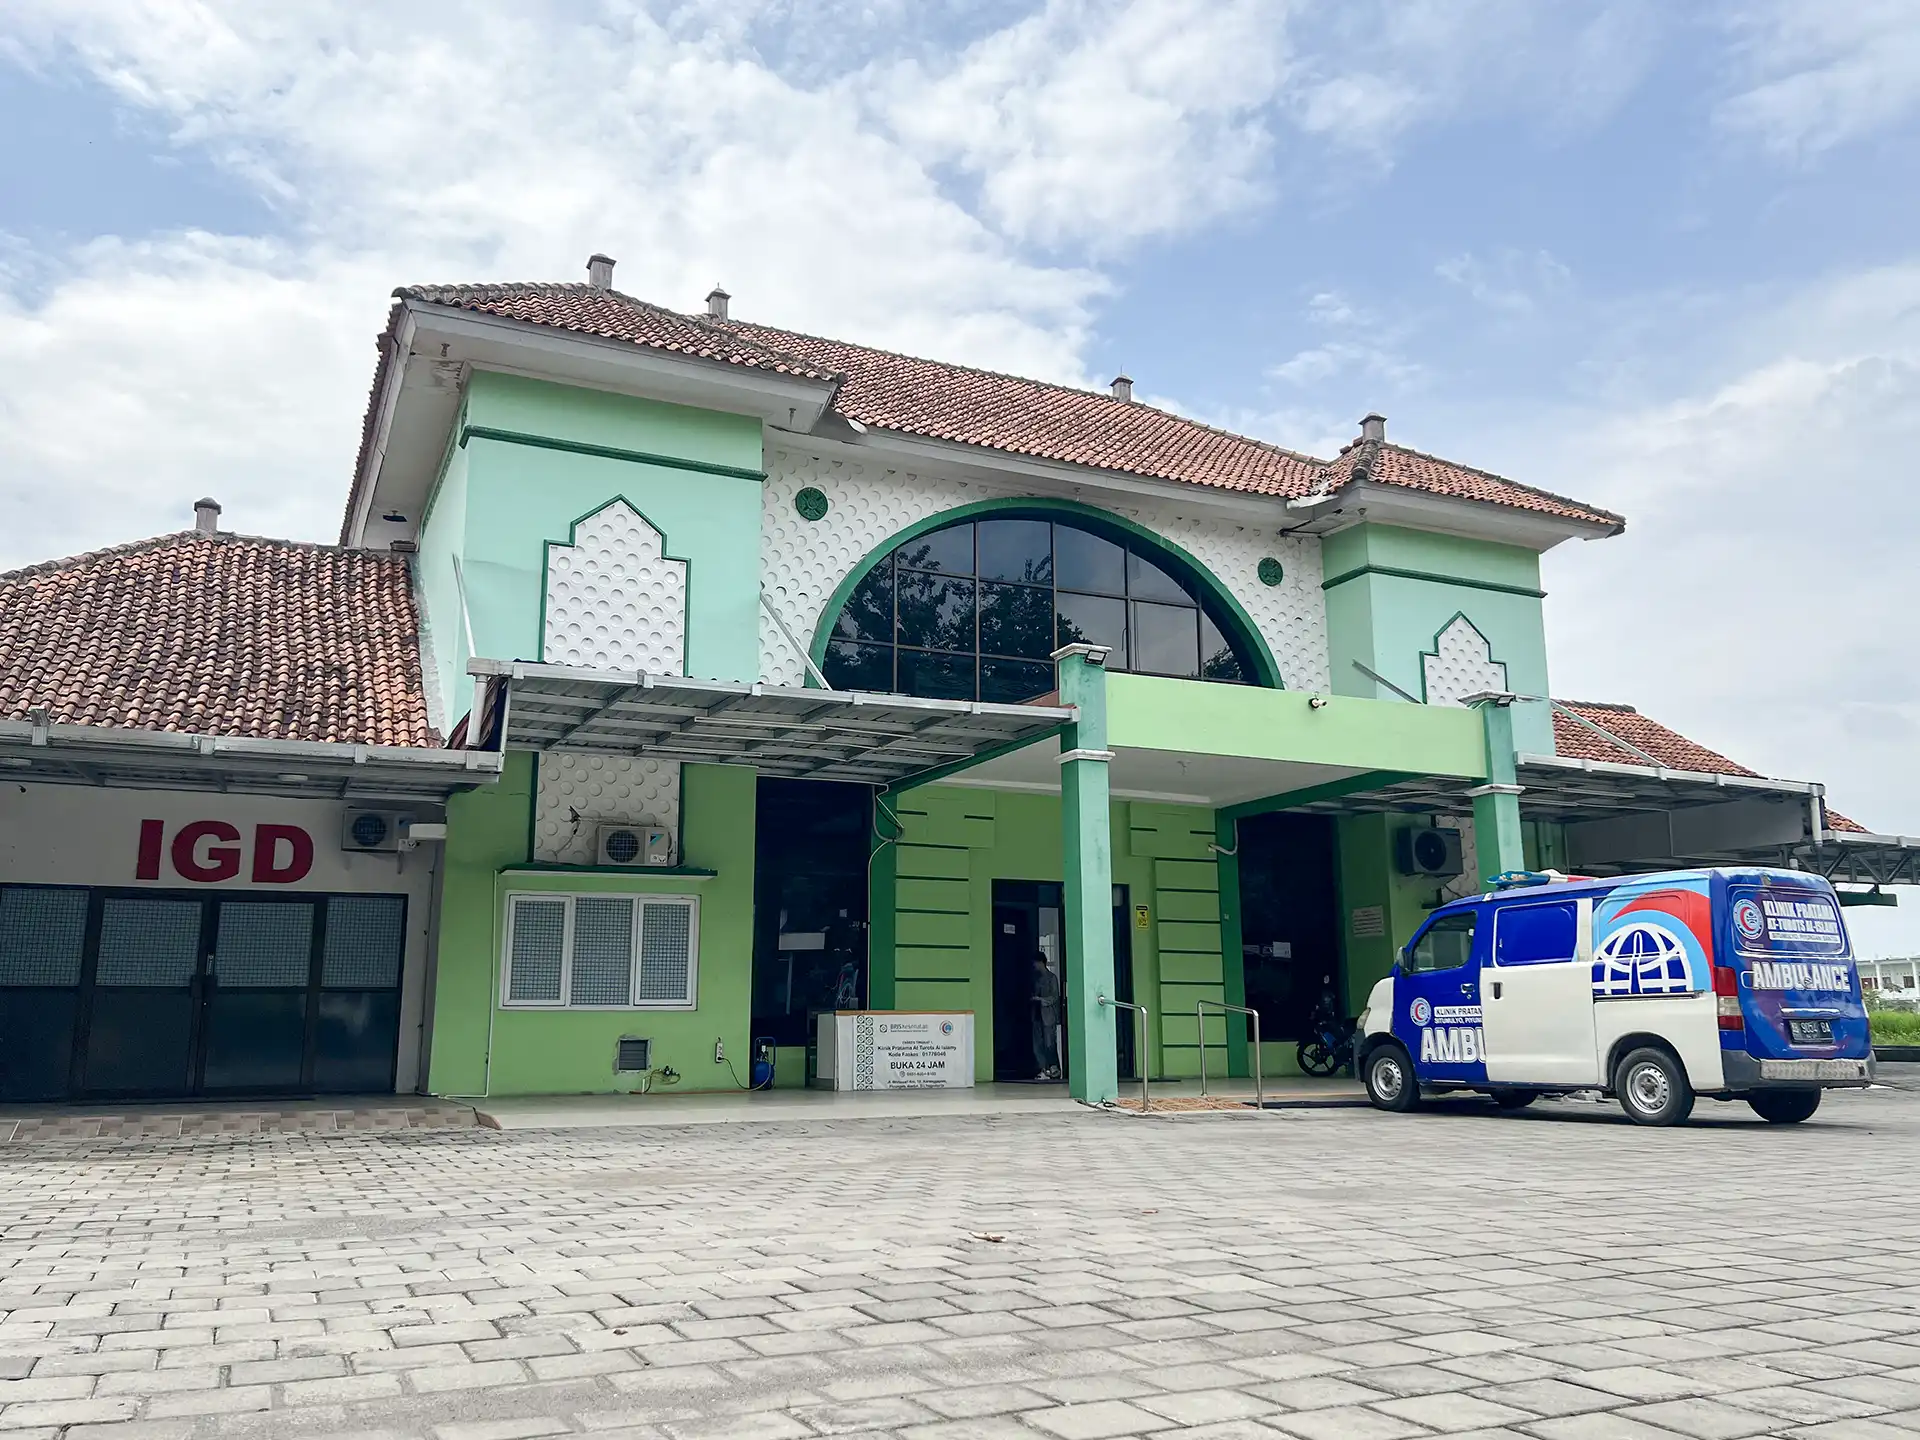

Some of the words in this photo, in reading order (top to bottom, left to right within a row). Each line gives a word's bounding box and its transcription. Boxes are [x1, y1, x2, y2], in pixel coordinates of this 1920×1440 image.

[135, 818, 314, 883] IGD
[1762, 900, 1797, 918] KLINIK
[1795, 903, 1837, 921] PRATAMA
[1752, 961, 1851, 992] AMBULANCE
[1435, 1008, 1457, 1016] KLINIK
[890, 1061, 914, 1070] BUKA
[915, 1061, 926, 1069] 24
[927, 1060, 945, 1069] JAM
